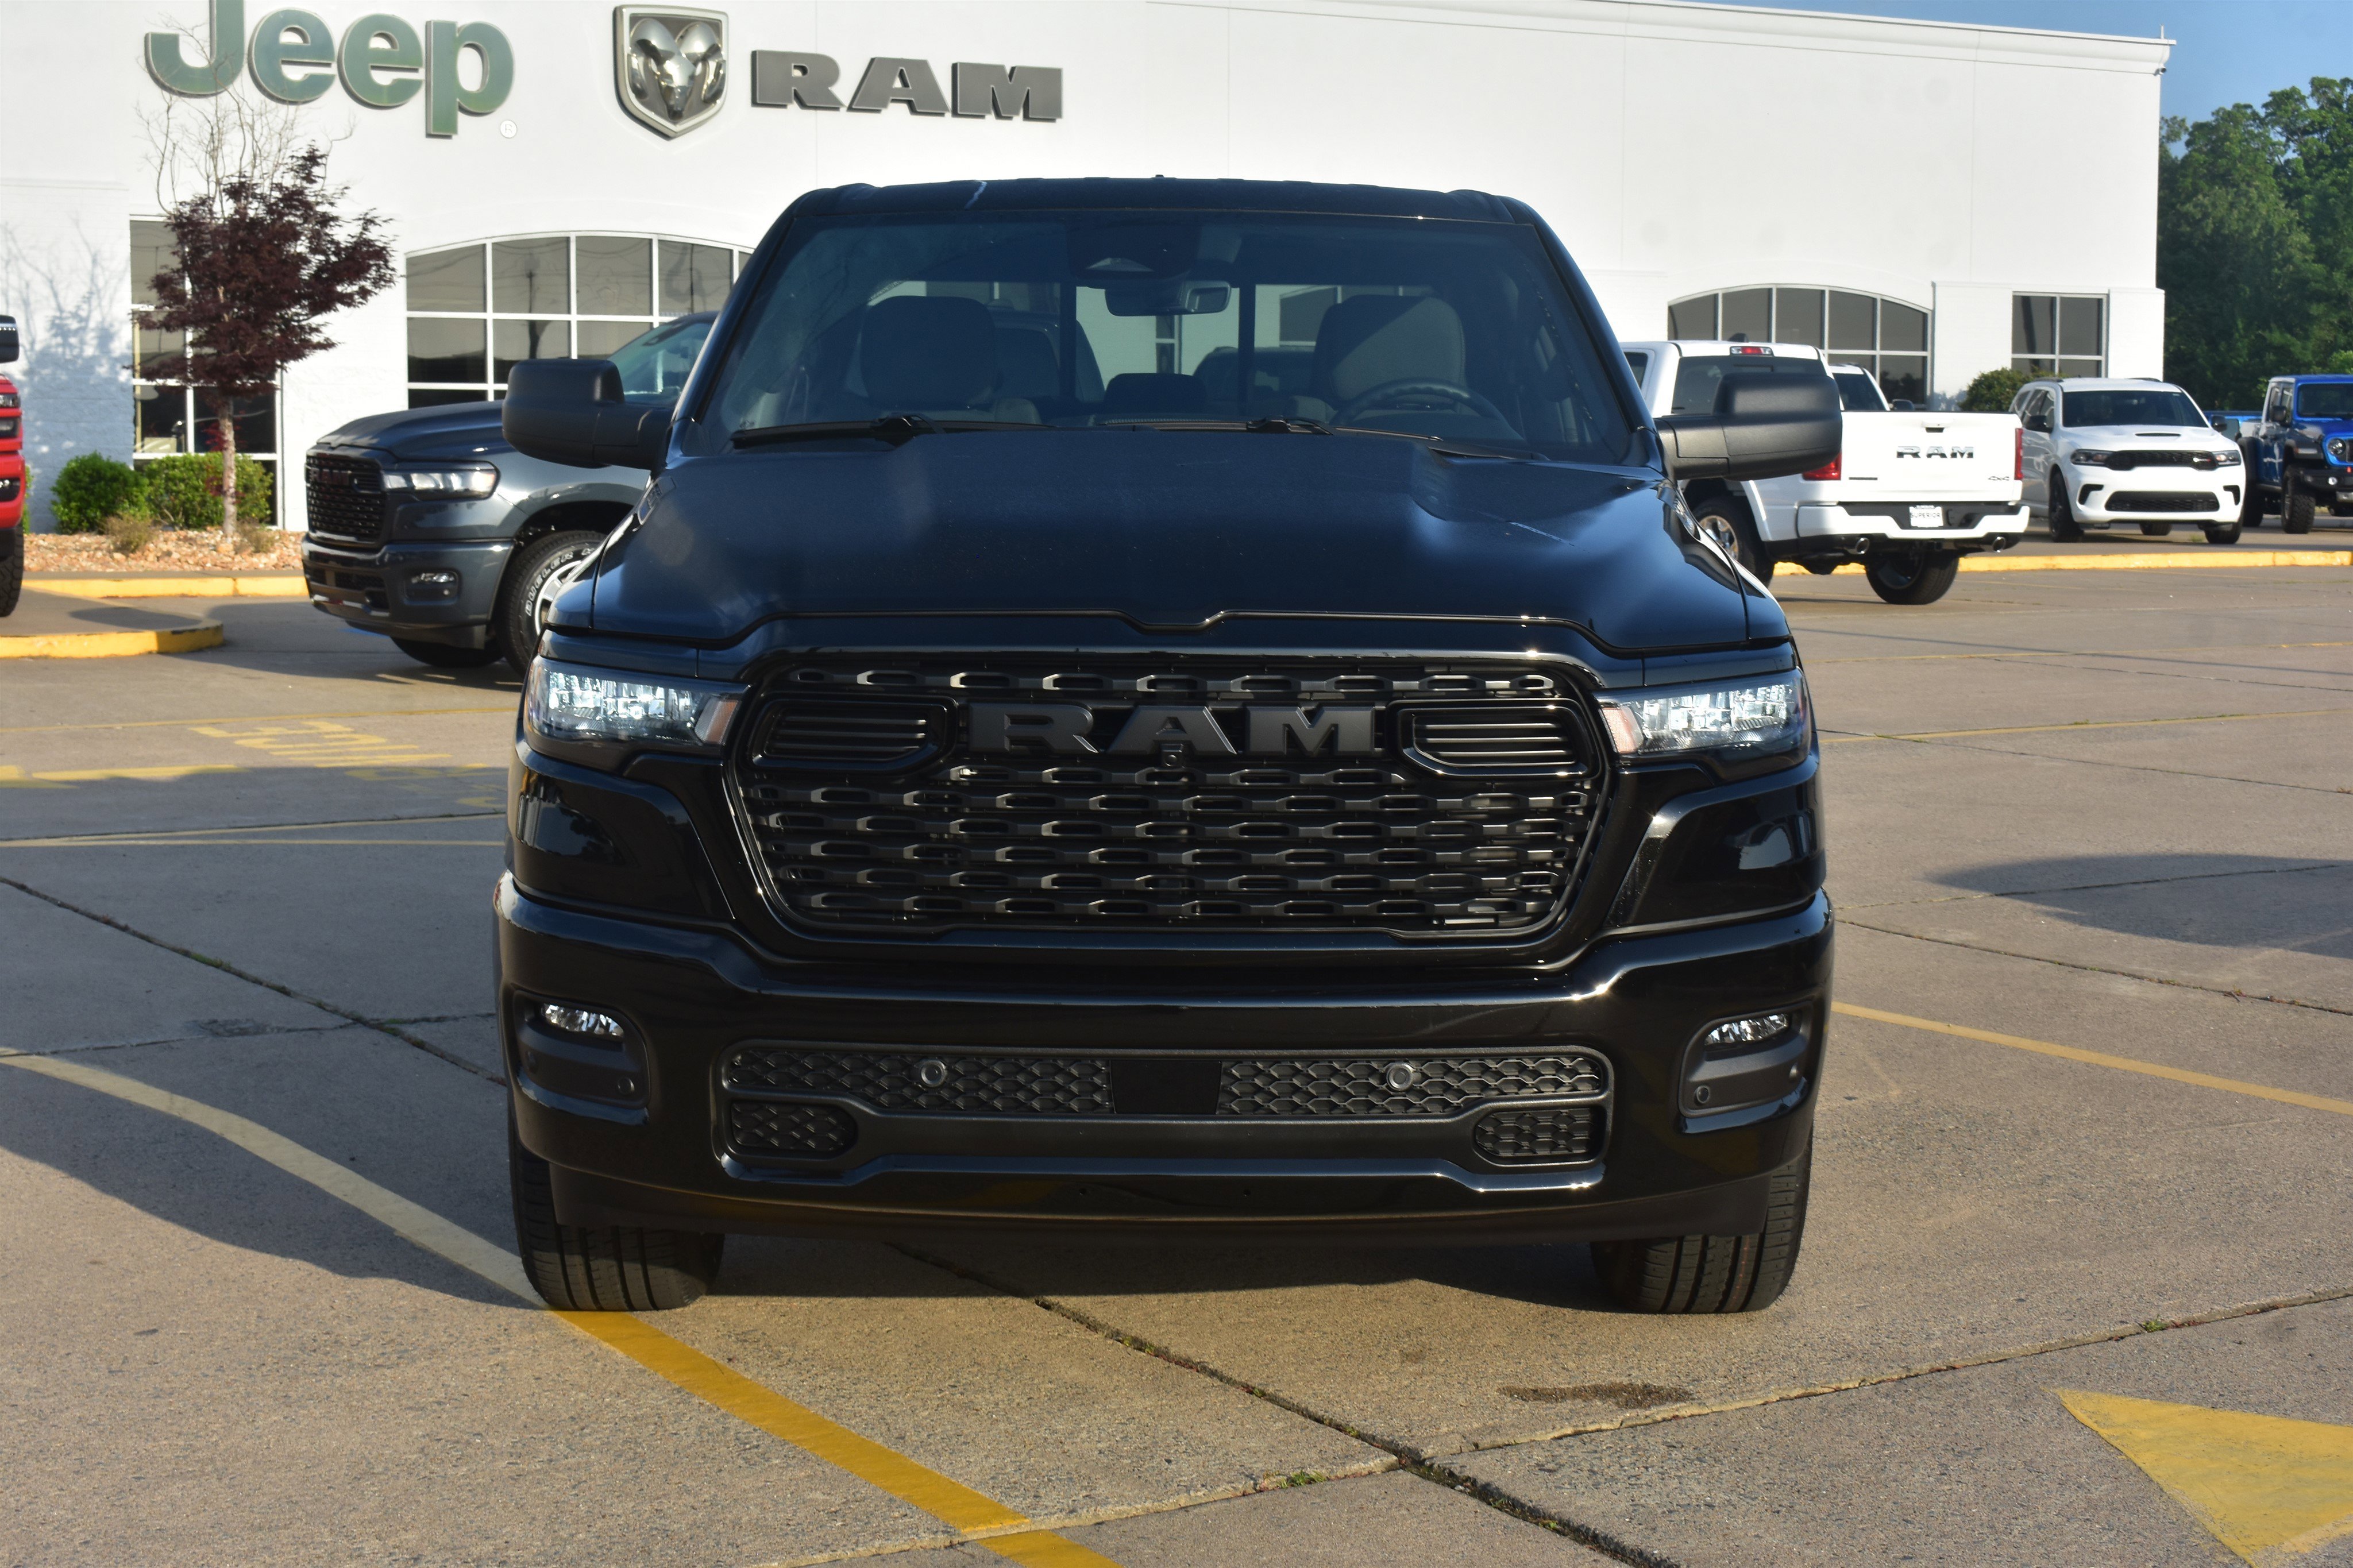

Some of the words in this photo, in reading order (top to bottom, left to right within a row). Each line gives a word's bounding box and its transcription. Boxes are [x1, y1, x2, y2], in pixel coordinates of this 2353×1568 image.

[144, 0, 516, 138] Jeep
[751, 49, 1063, 123] RAM
[1896, 446, 1974, 458] RAM
[525, 551, 574, 617] DUELER
[968, 703, 1377, 756] RAM
